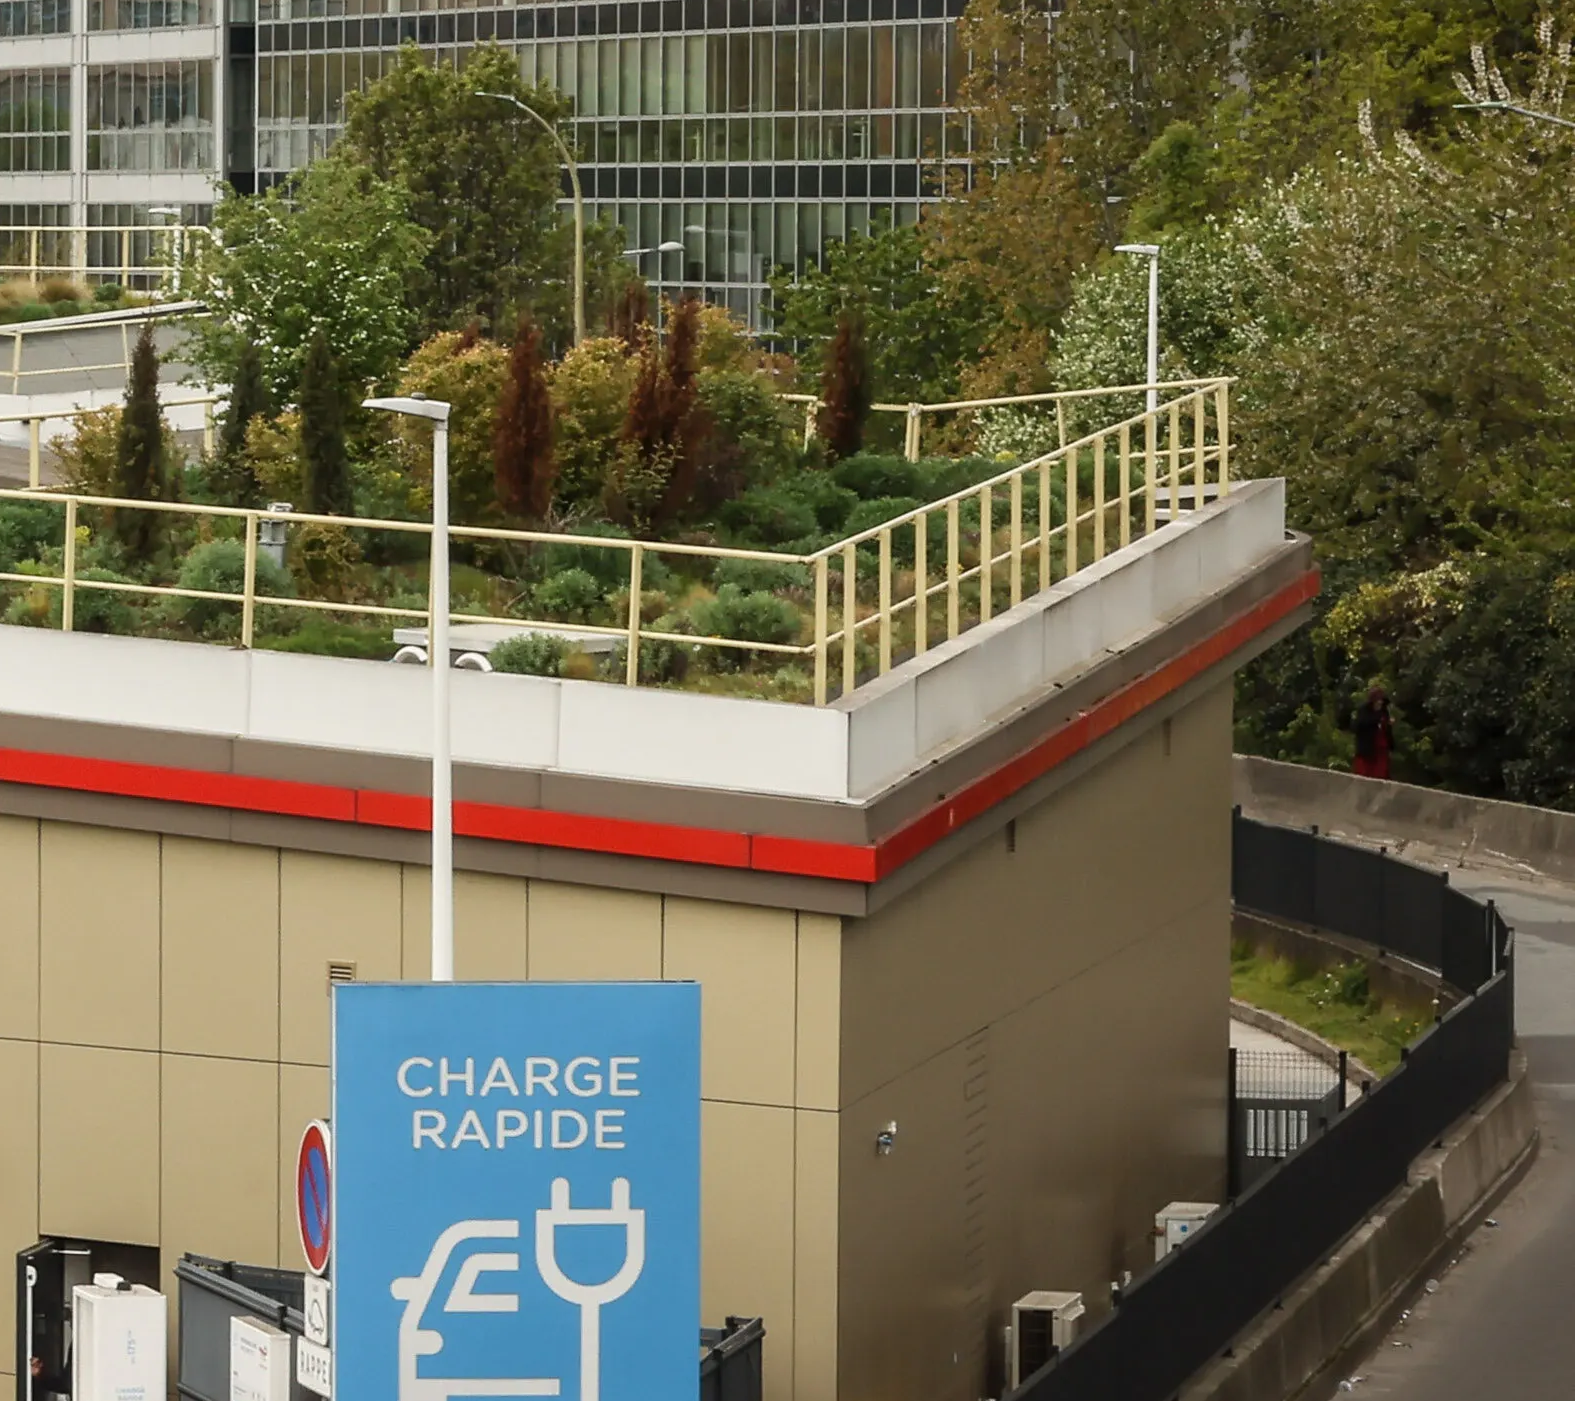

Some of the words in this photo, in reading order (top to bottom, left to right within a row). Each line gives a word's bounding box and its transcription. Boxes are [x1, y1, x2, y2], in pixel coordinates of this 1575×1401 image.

[397, 1056, 641, 1098] CHARGE
[411, 1110, 626, 1150] RAPIDE
[299, 1350, 328, 1384] RAPPE
